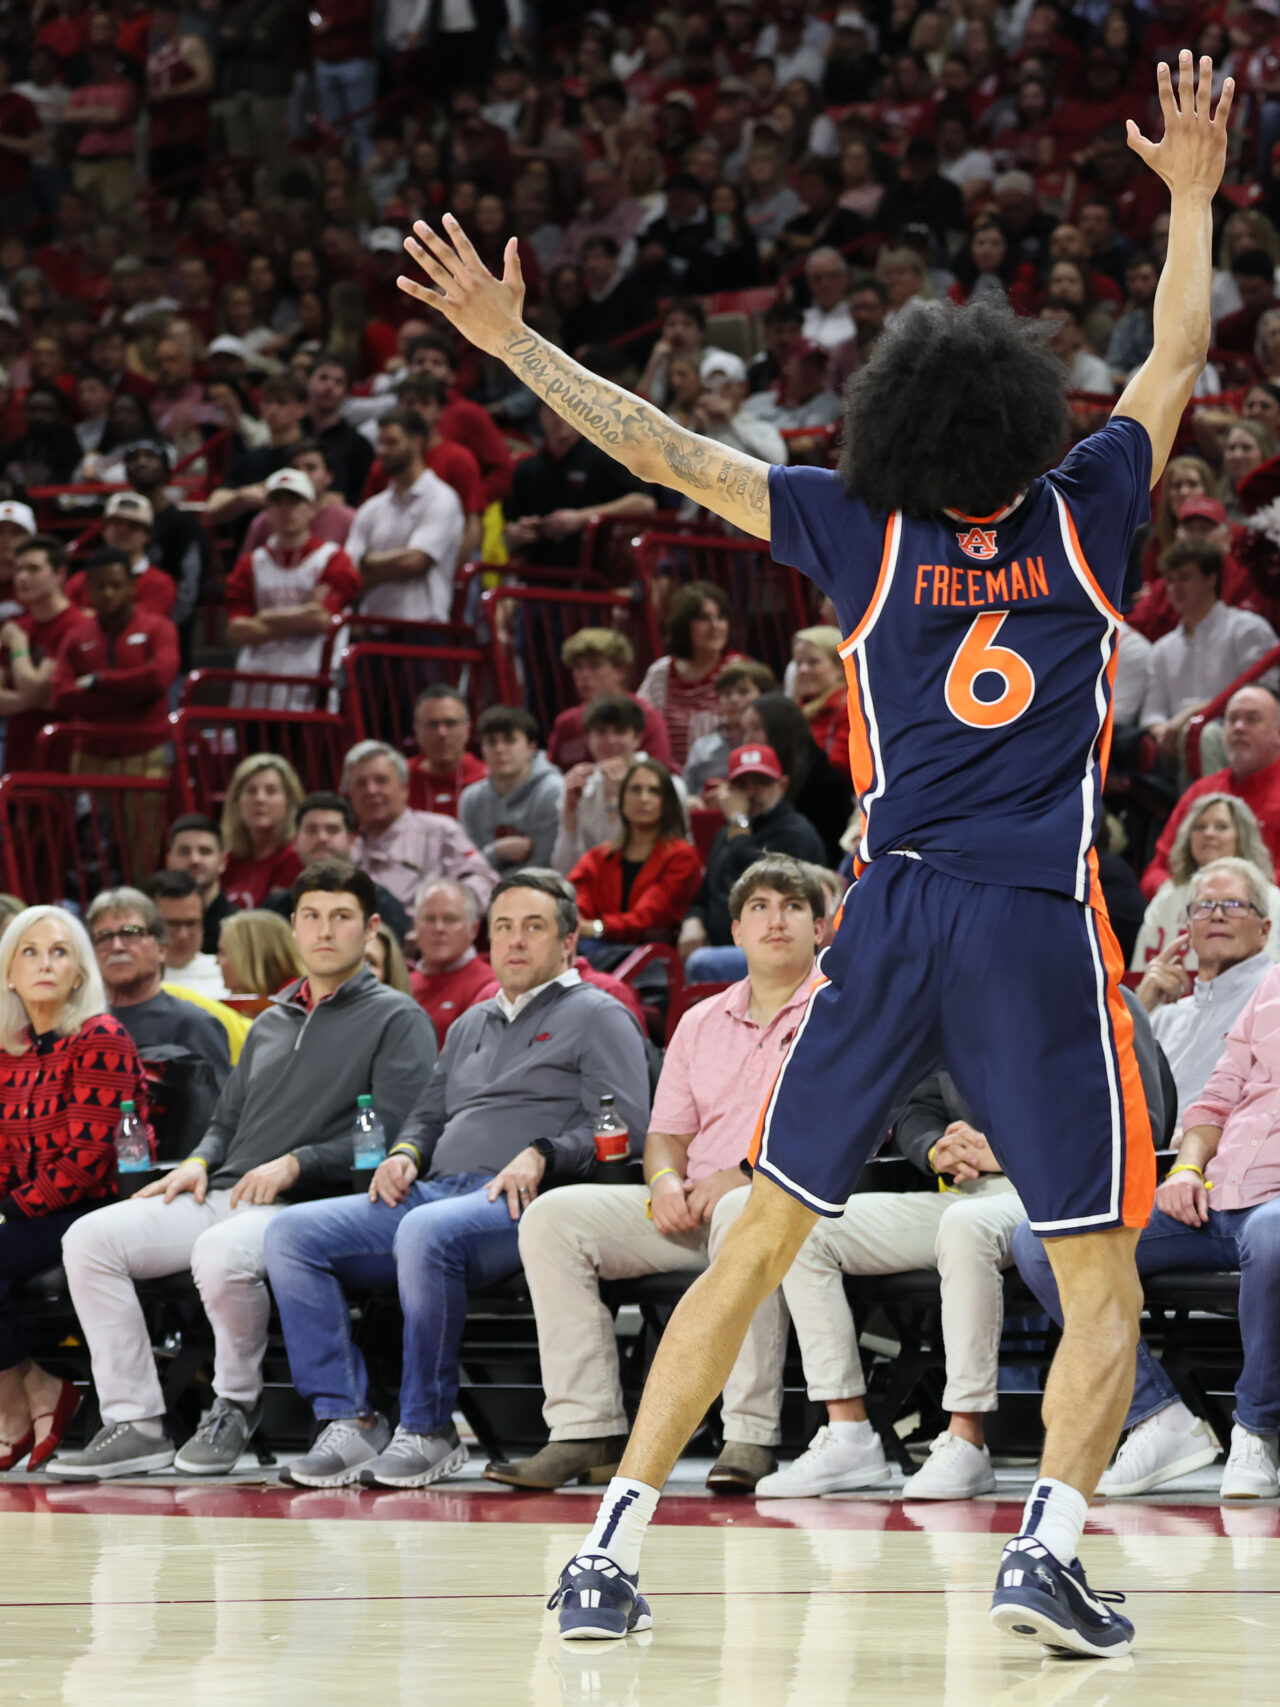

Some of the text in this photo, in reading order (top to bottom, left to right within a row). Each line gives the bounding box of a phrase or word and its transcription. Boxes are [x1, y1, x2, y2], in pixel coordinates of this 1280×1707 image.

[504, 332, 620, 445] Dios primero
[914, 556, 1050, 607] FREEMAN
[944, 609, 1036, 730] 6
